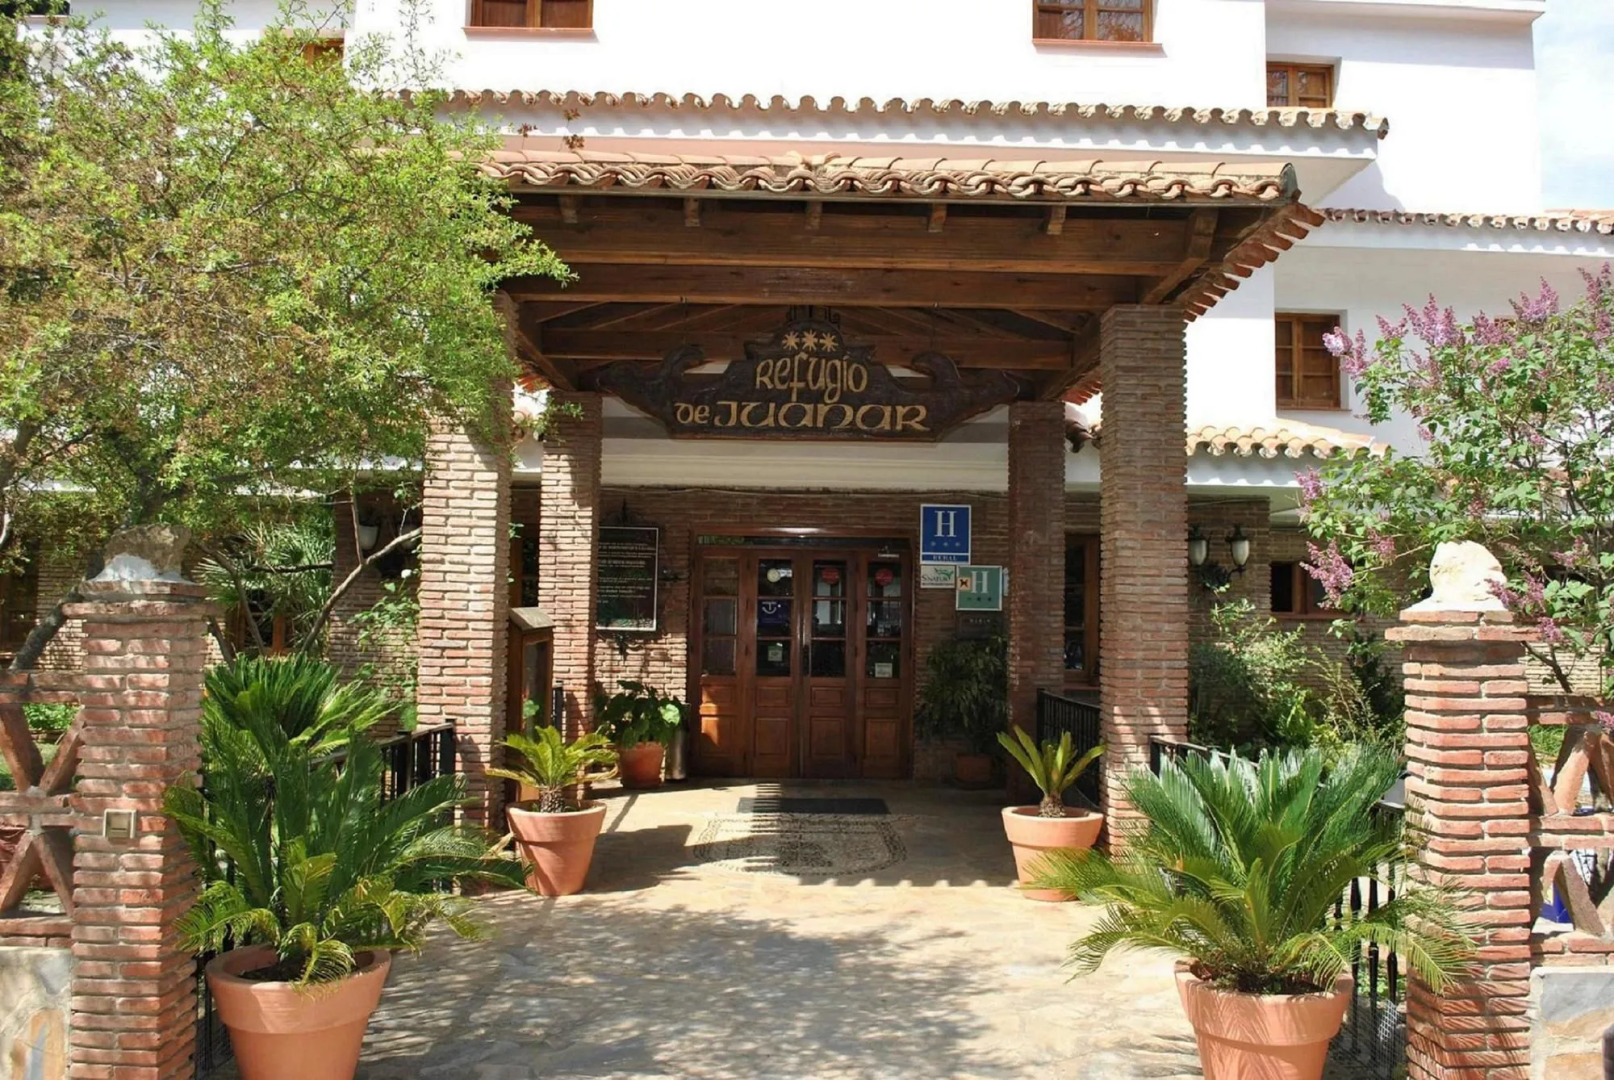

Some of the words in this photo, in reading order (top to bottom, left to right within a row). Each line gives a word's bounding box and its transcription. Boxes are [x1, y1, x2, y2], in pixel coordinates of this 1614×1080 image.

[756, 354, 867, 404] Refugio
[674, 402, 710, 424] de
[934, 510, 957, 537] H
[971, 570, 989, 594] H
